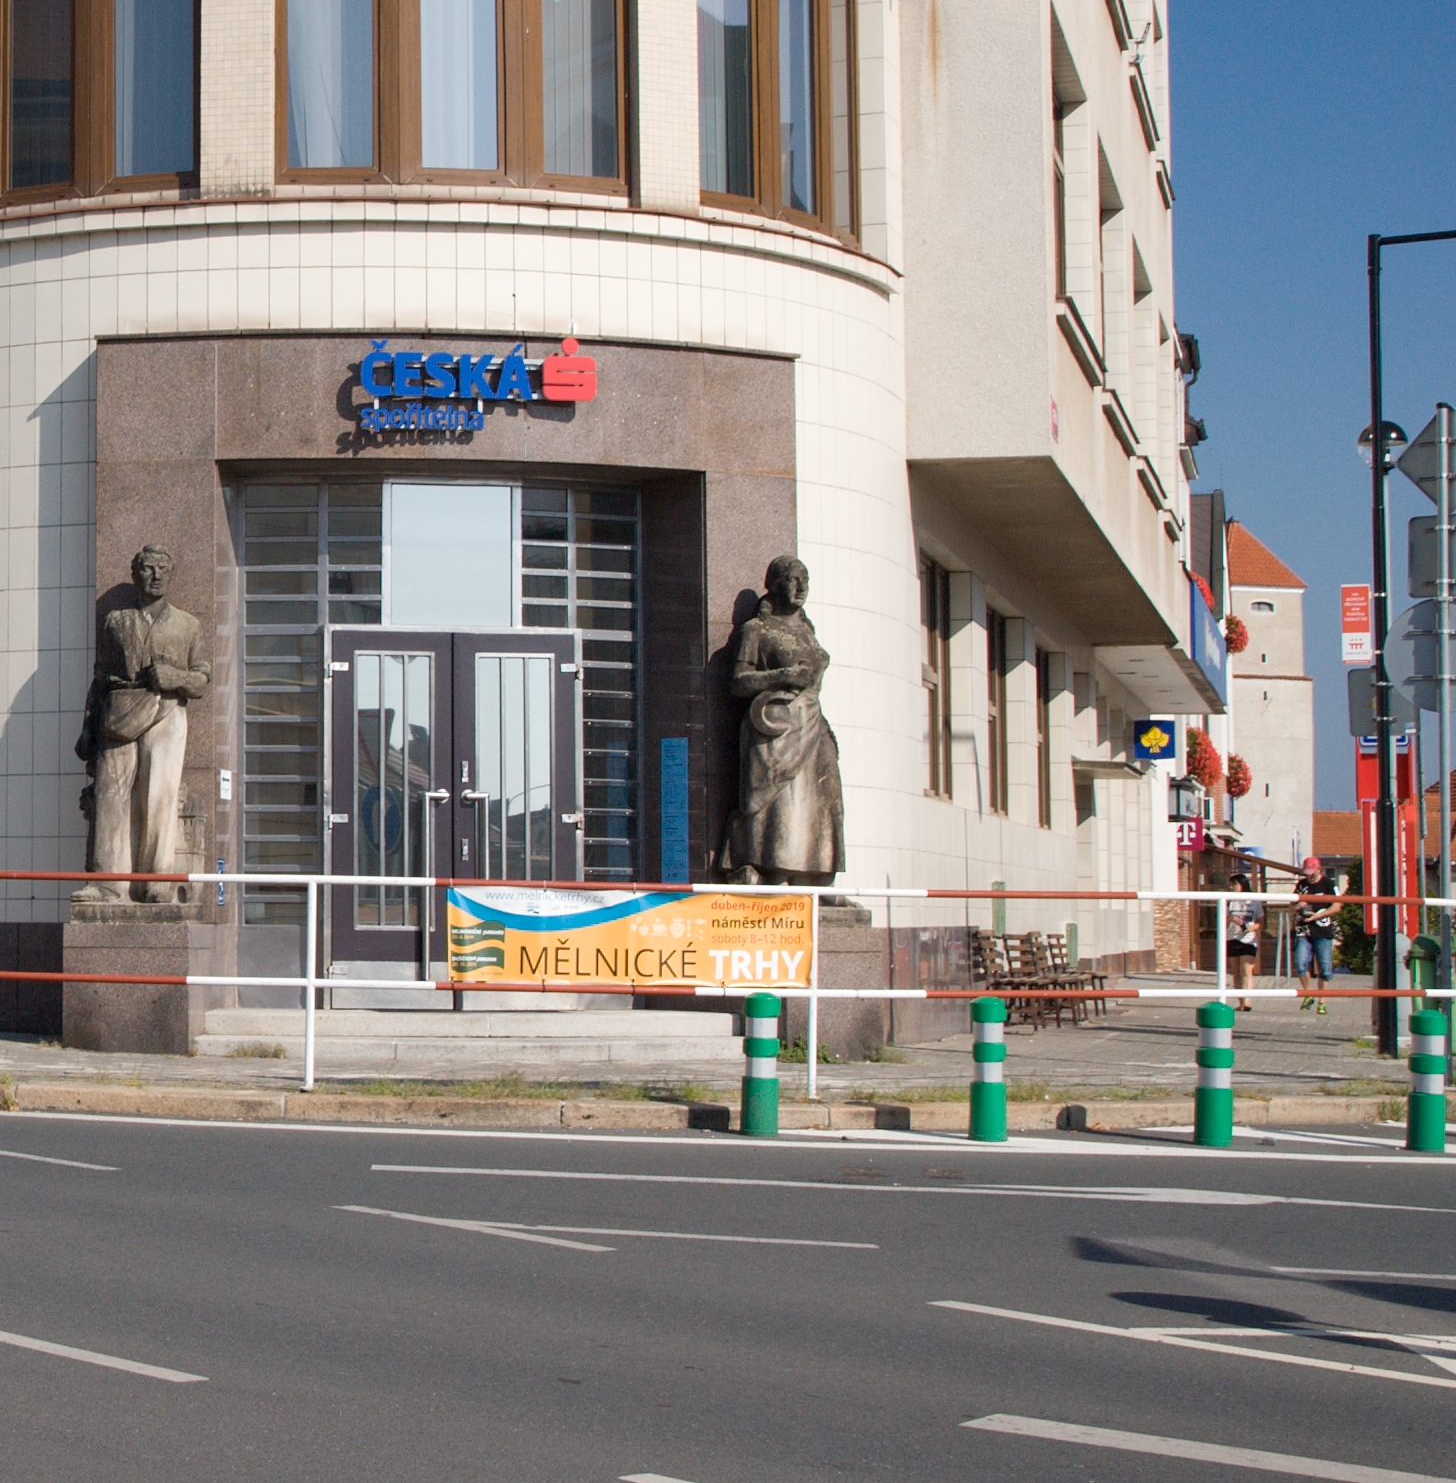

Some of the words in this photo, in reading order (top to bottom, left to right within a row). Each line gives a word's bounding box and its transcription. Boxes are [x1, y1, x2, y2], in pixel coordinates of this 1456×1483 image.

[360, 340, 532, 400] ČESKÁ
[360, 402, 485, 432] spořitelna
[485, 889, 605, 905] www.melnicketrhy.cz
[779, 901, 805, 911] 2019
[711, 916, 769, 929] náměstí
[771, 917, 804, 929] Míru
[711, 934, 747, 946] soboty
[780, 933, 805, 944] hod.
[519, 938, 697, 978] MĚLNICKÉ
[709, 949, 804, 980] TRHY
